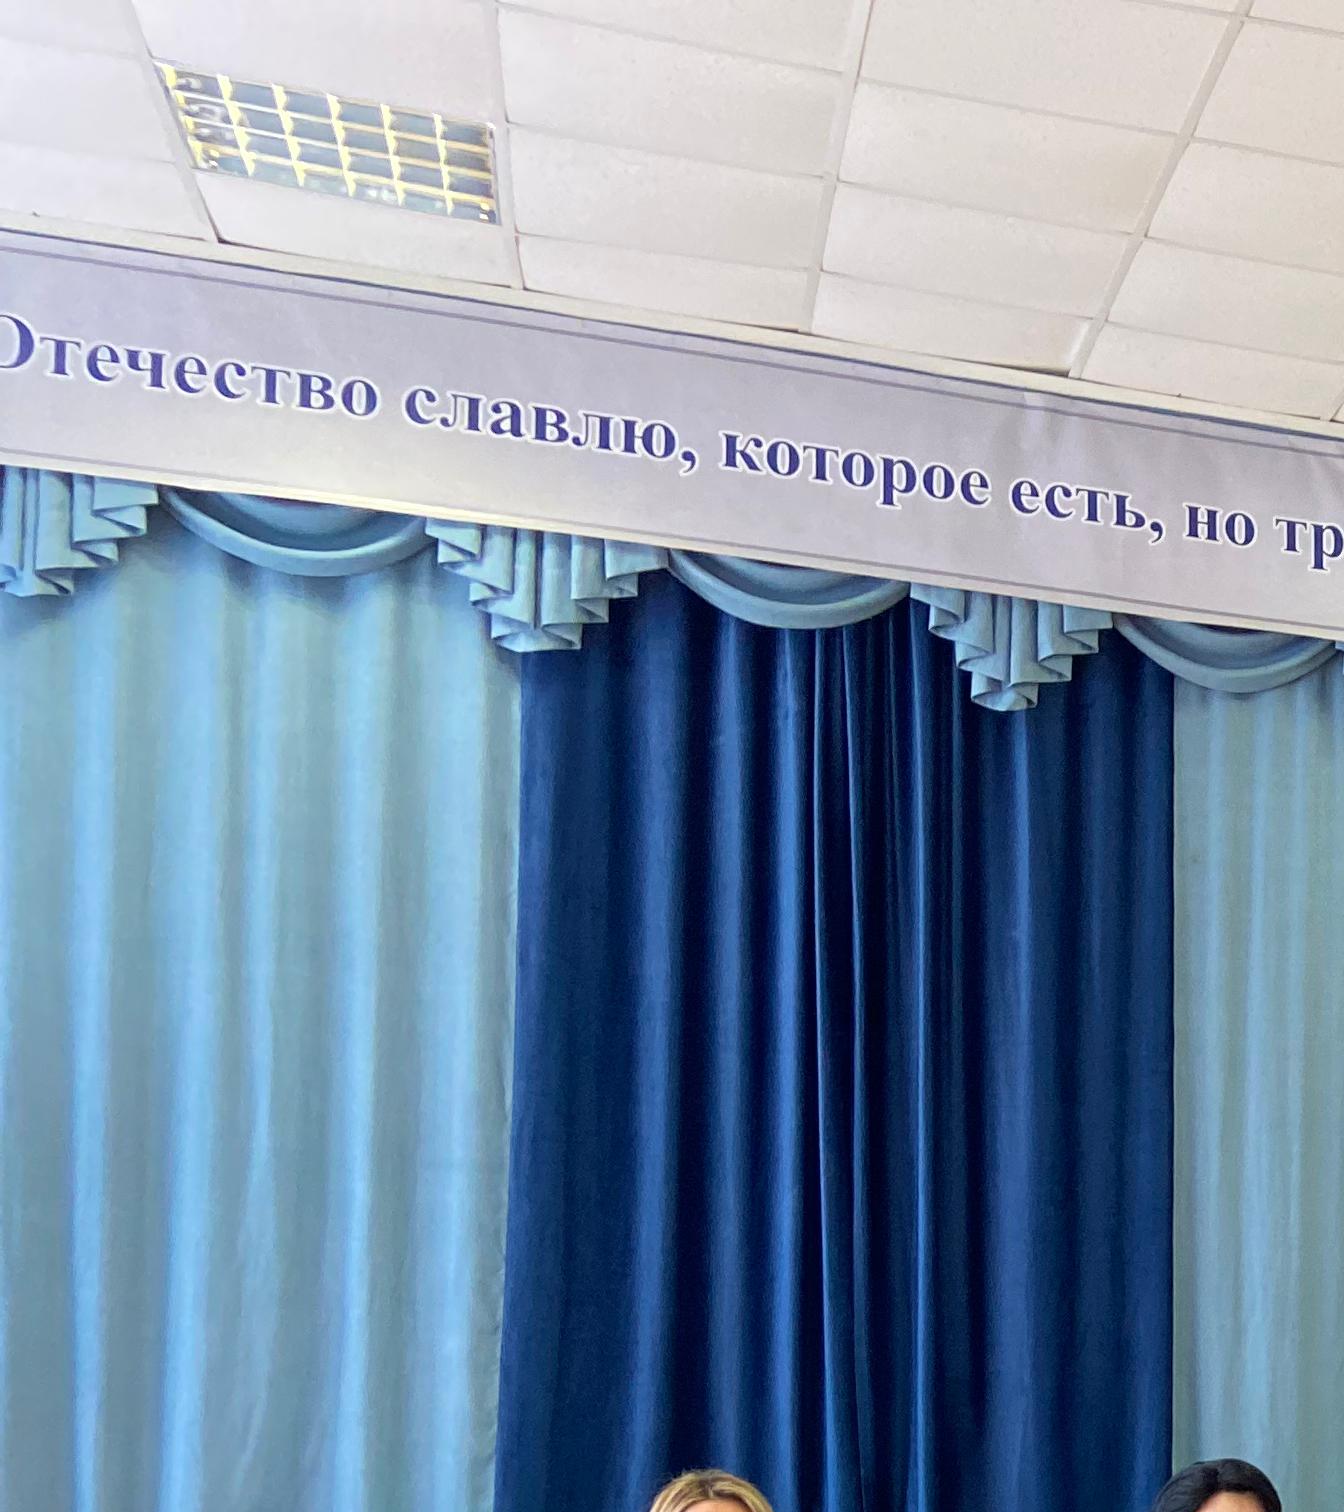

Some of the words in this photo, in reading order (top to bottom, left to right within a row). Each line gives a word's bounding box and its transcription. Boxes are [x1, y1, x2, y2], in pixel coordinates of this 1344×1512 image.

[0, 314, 378, 416] Отечество
[405, 388, 697, 473] славлю,
[722, 433, 989, 506] которое
[1011, 479, 1164, 543] есть,
[1185, 505, 1255, 546] но
